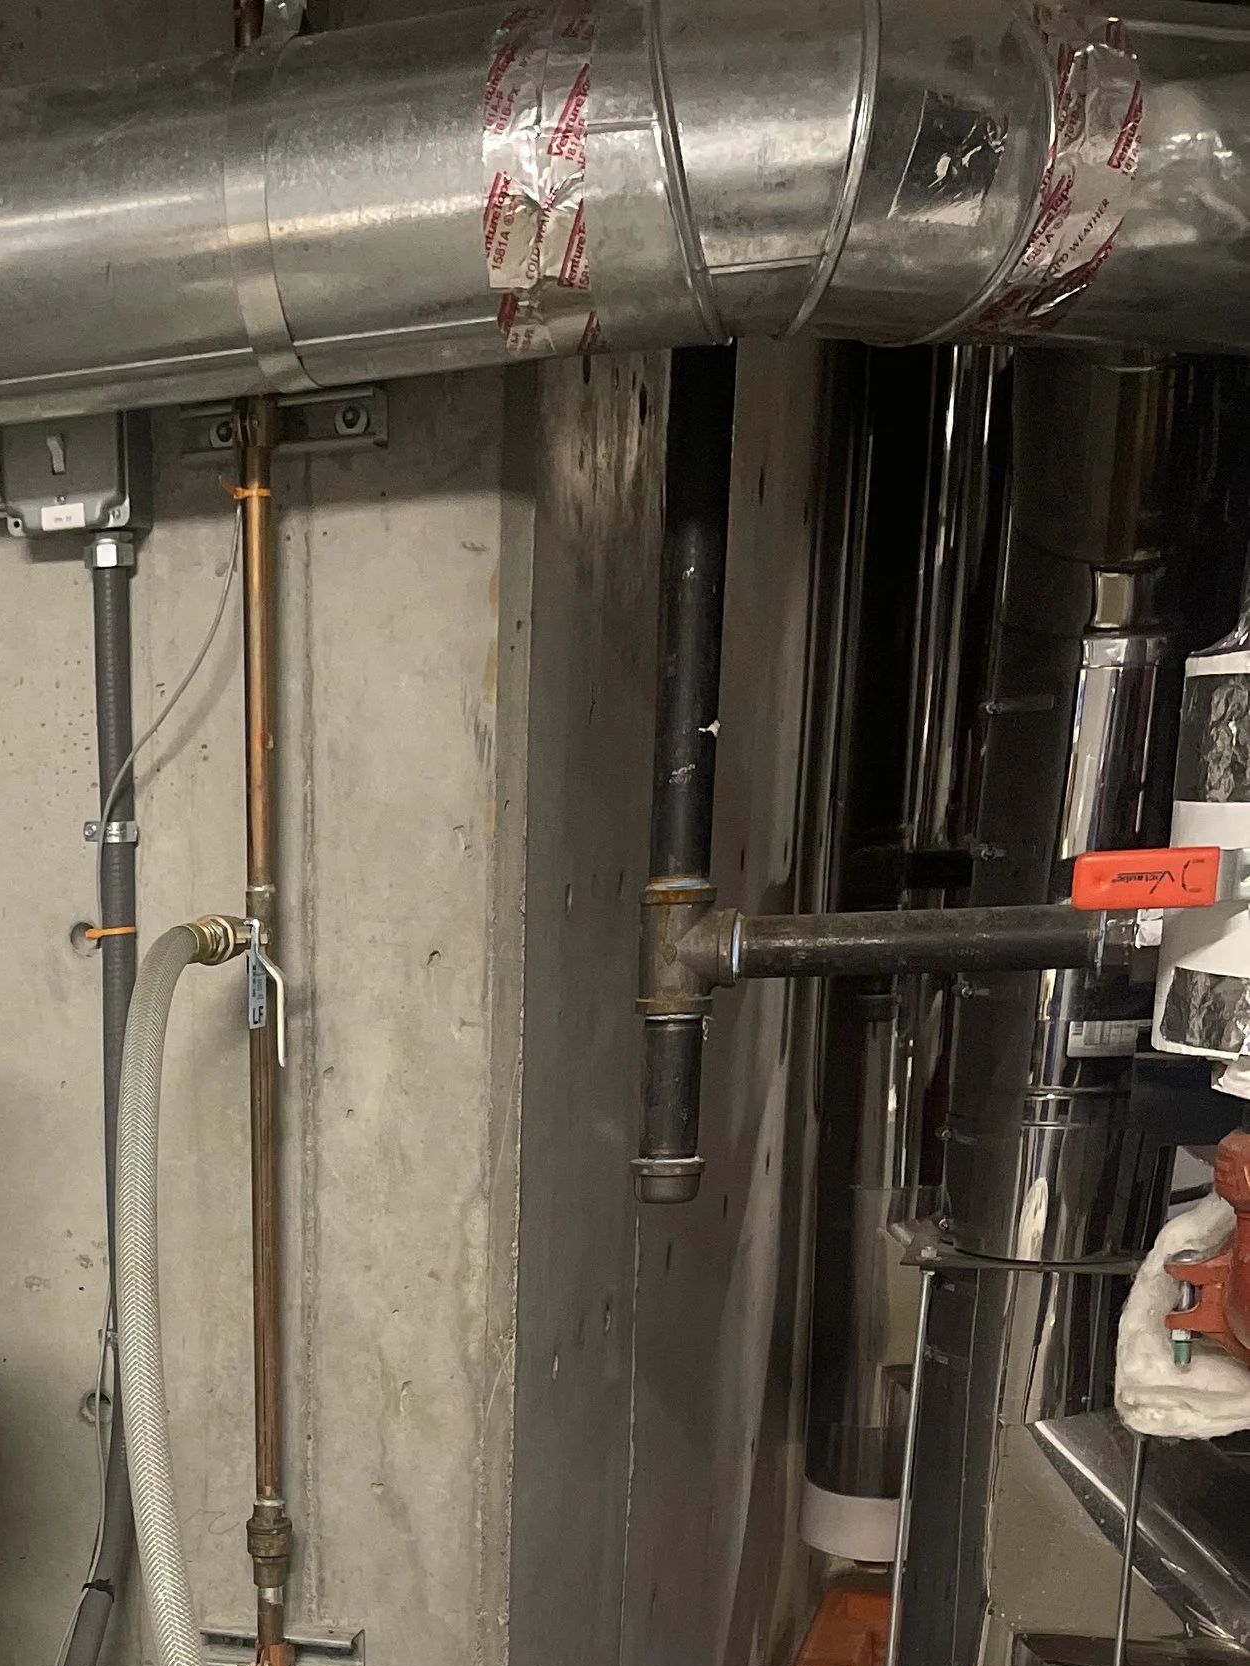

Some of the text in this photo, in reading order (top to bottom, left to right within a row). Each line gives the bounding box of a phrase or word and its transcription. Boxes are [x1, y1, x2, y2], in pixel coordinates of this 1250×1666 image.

[1069, 198, 1111, 251] WEATHER
[492, 231, 511, 270] 1581A
[1022, 233, 1055, 267] 1581A
